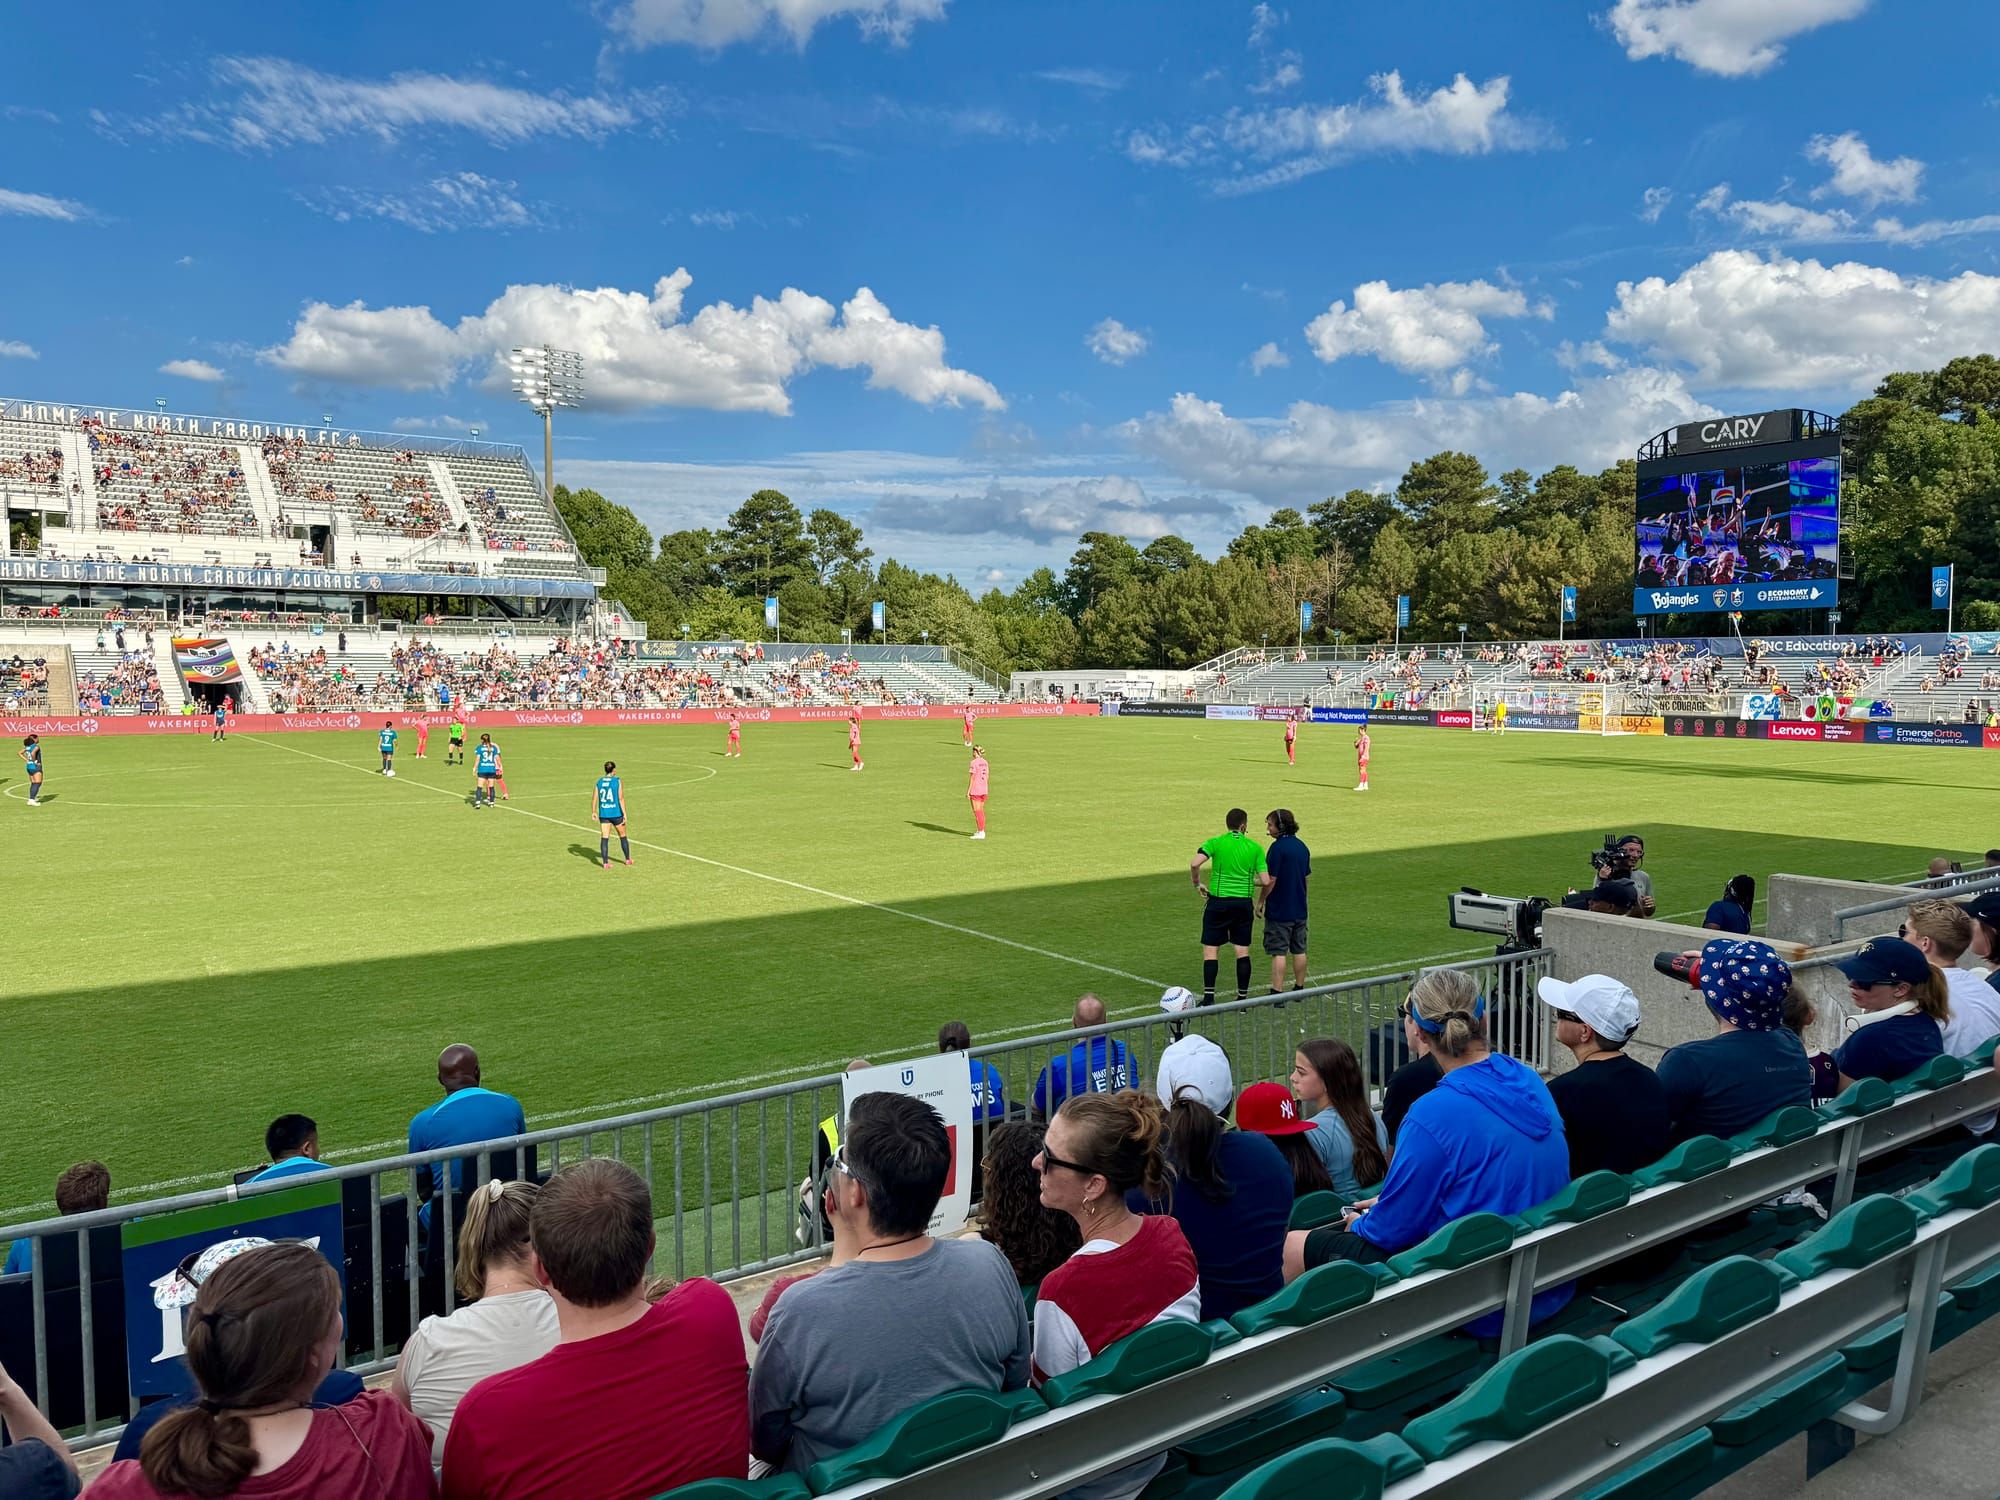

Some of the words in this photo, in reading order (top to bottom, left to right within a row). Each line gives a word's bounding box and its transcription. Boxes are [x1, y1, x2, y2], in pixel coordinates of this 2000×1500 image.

[22, 404, 79, 426] HOME
[134, 413, 199, 434] NORTH
[319, 430, 341, 447] FC
[1701, 416, 1765, 442] CARY
[1, 561, 49, 578] HOME
[61, 564, 82, 579] OF
[95, 565, 126, 581] THE
[138, 567, 193, 583] NORTH
[204, 569, 282, 587] CAROLINA
[293, 573, 362, 589] COURAGE
[1767, 588, 1808, 597] ECONOMY
[1767, 594, 1809, 602] EXTERMINATORS
[1651, 592, 1699, 609] Bojangles
[1786, 640, 1847, 652] Education
[1660, 701, 1670, 711] NC
[1672, 701, 1707, 711] COURAGE
[1749, 696, 1781, 720] 94
[618, 712, 682, 721] WAKEMED.ORG
[880, 708, 920, 717] WakeMed
[1339, 712, 1366, 721] Paperwork
[282, 716, 346, 728] WakeMed
[516, 713, 570, 724] WakeMed
[1440, 715, 1470, 724] Lenovo
[1627, 717, 1652, 728] BEES
[4, 717, 80, 734] WakeMed
[1772, 725, 1817, 736] Lenovo
[1896, 728, 1962, 739] EmergeOrtho
[384, 735, 390, 744] 9
[1902, 736, 1933, 744] Orthopedic
[600, 788, 614, 802] 24
[925, 1089, 944, 1099] PHONE
